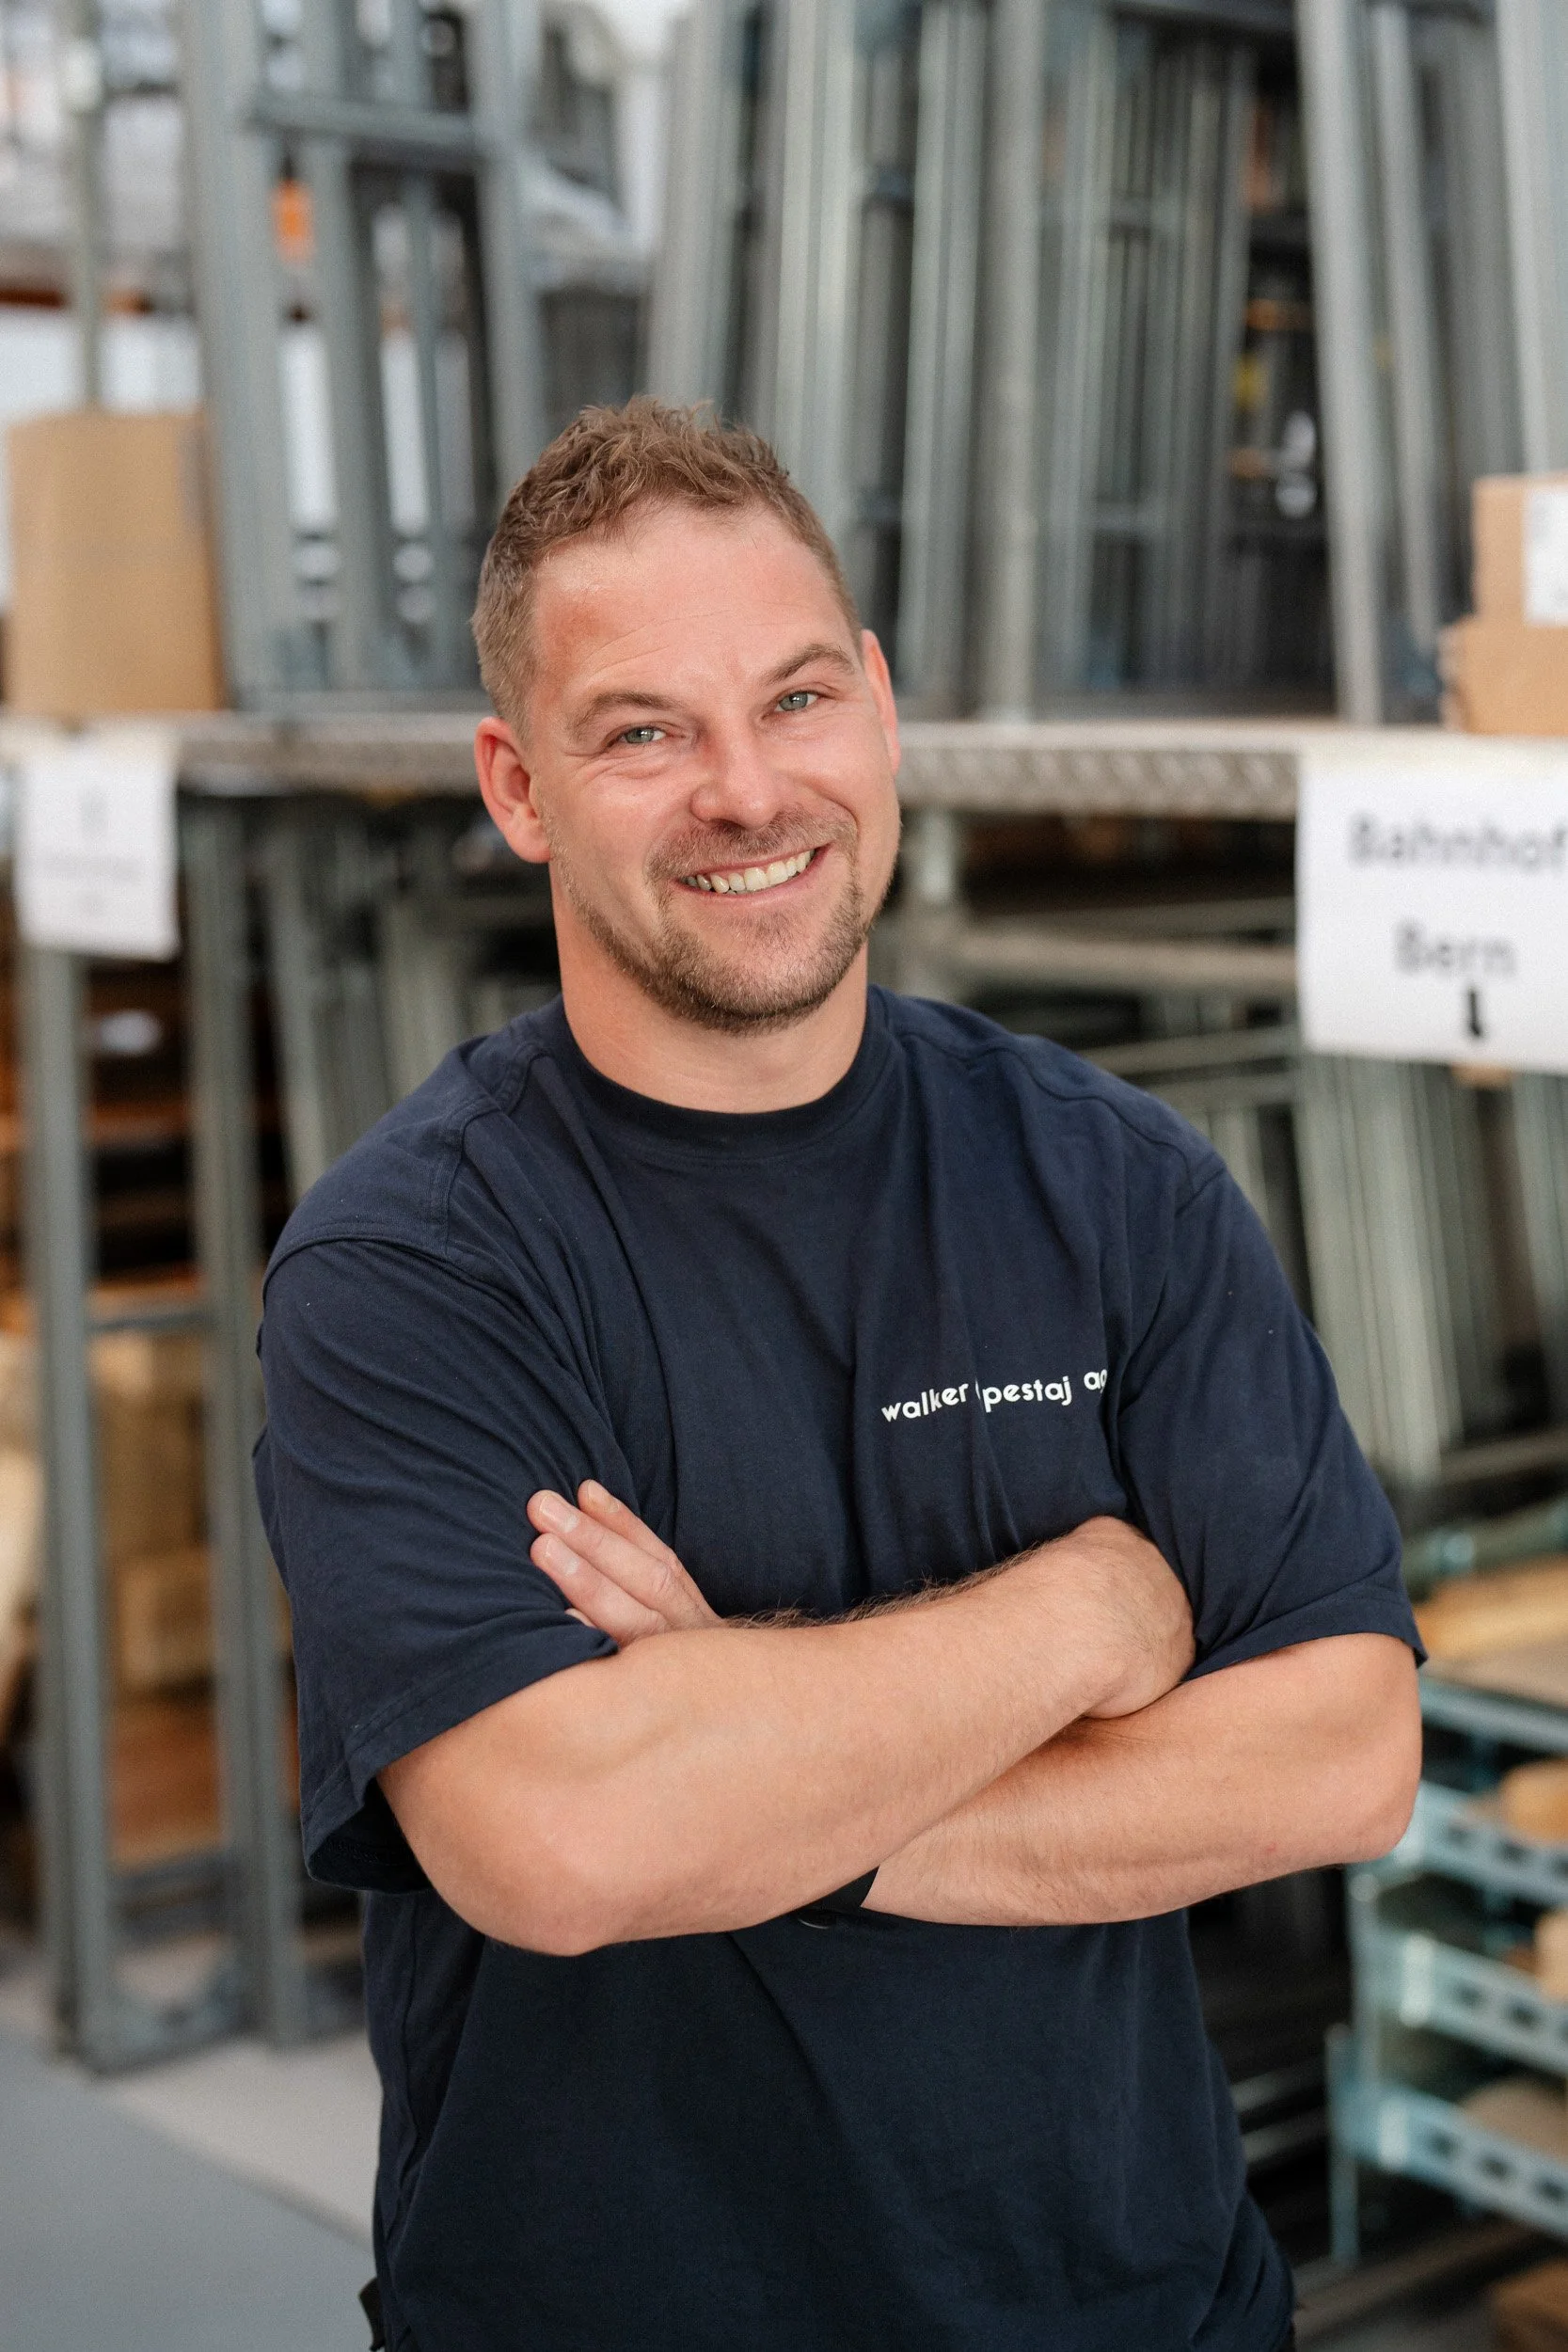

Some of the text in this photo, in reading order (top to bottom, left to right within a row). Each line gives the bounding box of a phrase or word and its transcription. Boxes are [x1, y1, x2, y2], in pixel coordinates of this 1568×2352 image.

[1350, 813, 1568, 875] Bahnhof
[1396, 919, 1517, 977] Bern
[881, 1383, 969, 1422] walker
